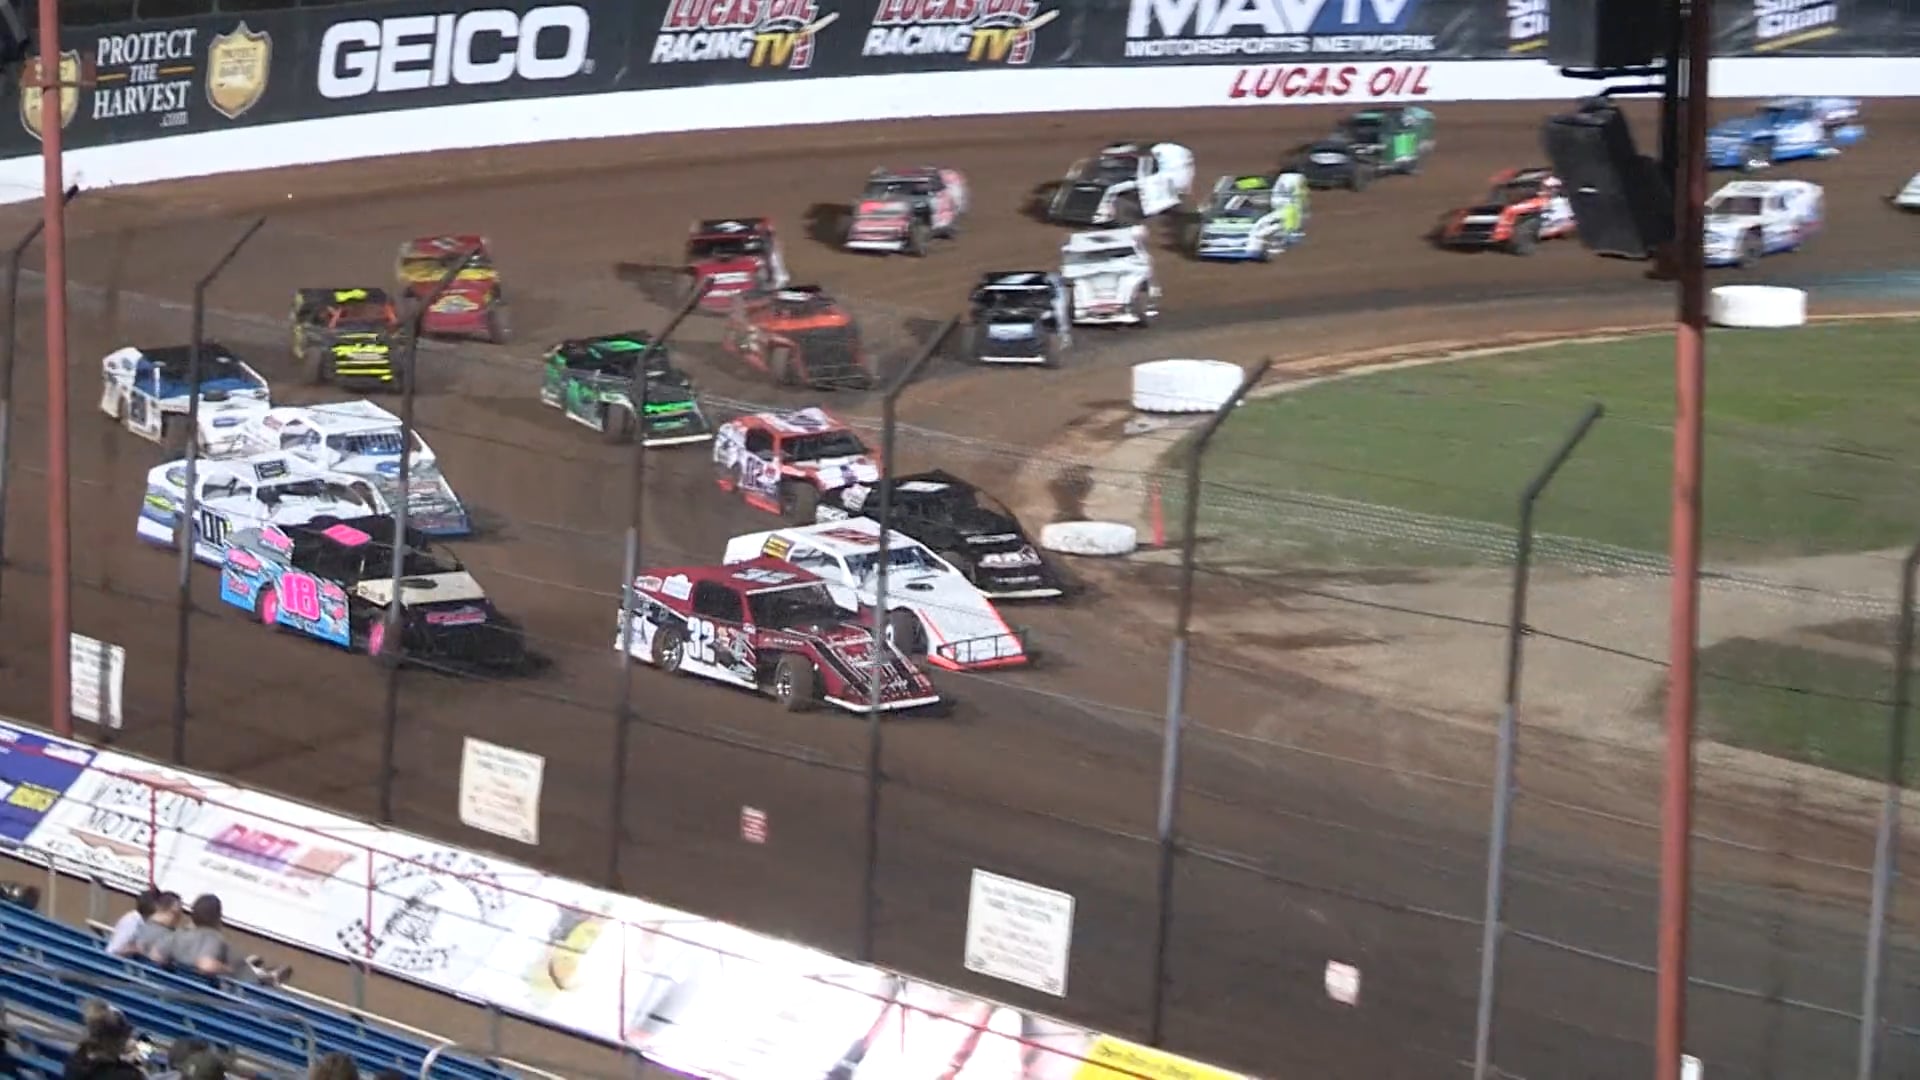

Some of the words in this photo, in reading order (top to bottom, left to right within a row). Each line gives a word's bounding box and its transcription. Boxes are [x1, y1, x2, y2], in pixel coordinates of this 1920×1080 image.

[96, 28, 198, 67] PROTECT
[317, 4, 590, 98] GEICO
[649, 30, 755, 64] RACING
[862, 25, 974, 56] RACING
[1124, 36, 1310, 57] MOTORSPORTS
[1312, 34, 1436, 51] NETWORK
[128, 63, 159, 82] THE
[1228, 66, 1358, 98] LUCAS
[1368, 65, 1432, 96] OIL
[92, 81, 192, 120] HARVEST
[281, 571, 320, 621] 18
[687, 616, 716, 666] 32
